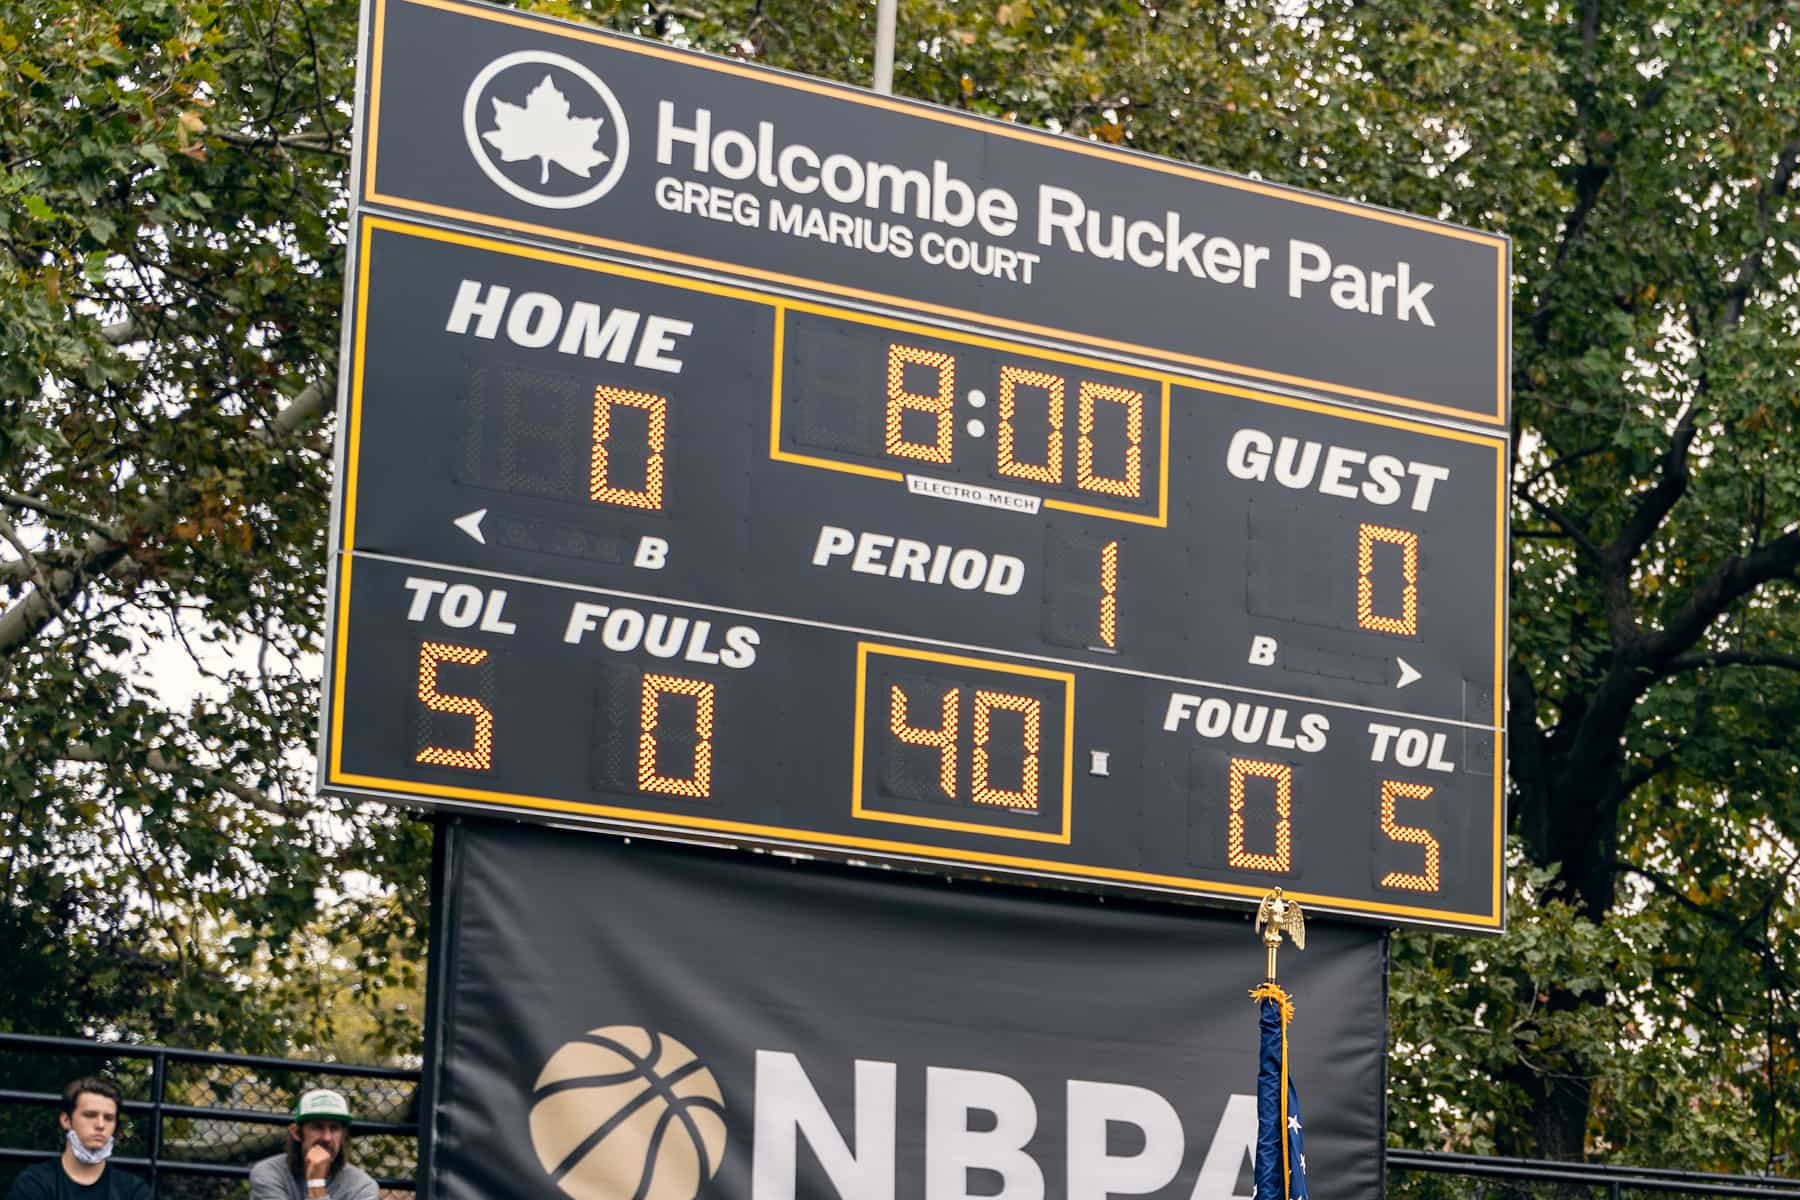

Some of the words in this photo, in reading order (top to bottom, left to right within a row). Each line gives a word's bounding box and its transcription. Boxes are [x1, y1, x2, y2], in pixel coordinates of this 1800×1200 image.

[655, 176, 760, 229] GREG
[769, 202, 913, 259] MARIUS
[920, 231, 1040, 284] COURT
[656, 100, 1018, 237] Holcombe
[1037, 184, 1270, 289] Rucker
[1288, 239, 1436, 326] Park
[445, 280, 693, 373] HOME
[590, 384, 666, 510] 0
[886, 343, 1142, 498] 8:00
[1226, 428, 1449, 512] GUEST
[634, 536, 669, 570] B
[812, 525, 1025, 596] PERIOD
[1100, 541, 1117, 648] 1
[1357, 523, 1418, 636] 0
[404, 577, 517, 634] TOL
[564, 601, 760, 669] FOULS
[1249, 635, 1277, 667] B
[416, 641, 494, 770] 5
[638, 672, 714, 798] 0
[890, 684, 1040, 809] 40
[1163, 692, 1330, 754] FOULS
[1367, 723, 1455, 773] TOL
[1229, 757, 1291, 872] 0
[1381, 780, 1439, 892] 5
